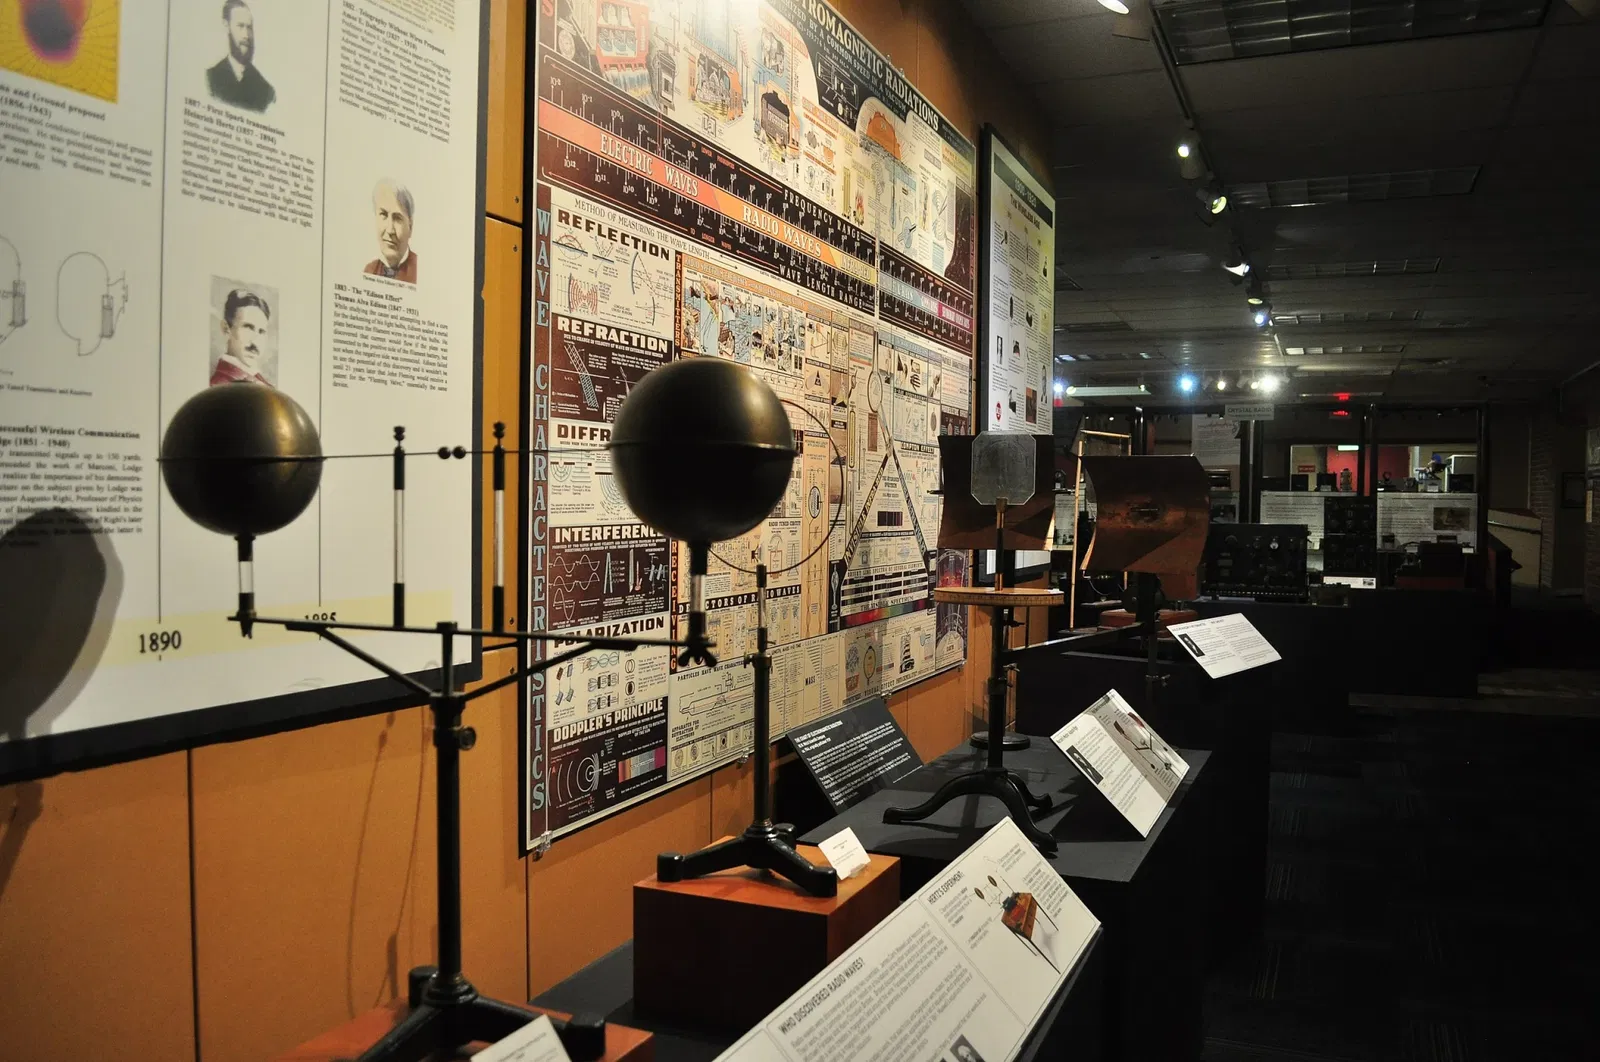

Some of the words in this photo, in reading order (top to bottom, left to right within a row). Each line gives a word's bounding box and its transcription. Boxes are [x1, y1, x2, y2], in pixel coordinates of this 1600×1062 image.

[826, 34, 853, 64] COMMON
[885, 66, 940, 132] RADIATIONS
[600, 133, 653, 175] ELECTRIC
[664, 164, 698, 197] WAVES
[743, 205, 779, 235] RADIO
[783, 224, 821, 257] WAVES
[784, 189, 833, 226] FREQUENCY
[837, 219, 861, 241] RANGE
[558, 209, 670, 262] REFLECTION
[574, 198, 606, 218] METHOD
[607, 211, 617, 222] OF
[618, 216, 655, 238] MEASURING
[656, 230, 669, 243] THE
[670, 236, 688, 251] WAVE
[688, 243, 710, 260] LENGTH
[352, 286, 362, 295] The
[536, 208, 551, 328] WAVE
[779, 264, 801, 283] WAVE
[806, 275, 835, 297] LENGTH
[839, 290, 863, 309] RANGE
[333, 292, 355, 303] Thomas
[370, 300, 387, 309] Edison
[674, 253, 682, 347] TRANSMITTERS
[557, 316, 668, 354] REFRACTION
[78, 427, 141, 439] Communication
[532, 364, 548, 811] CHARACTERISTICS
[678, 597, 734, 614] DECTORS
[737, 594, 748, 603] OF
[750, 588, 775, 602] RIO
[776, 585, 800, 597] WAVES
[138, 630, 182, 654] 1890
[677, 670, 700, 682] PARTICLES
[701, 667, 712, 676] HAVE
[713, 665, 724, 673] WAVE
[805, 675, 816, 686] MASS
[553, 712, 613, 744] DOPPLER'S
[614, 697, 663, 725] PRINCIPLE
[778, 1016, 797, 1035] WHO
[793, 987, 831, 1022] DISCOVERED
[826, 974, 846, 993] RADIO
